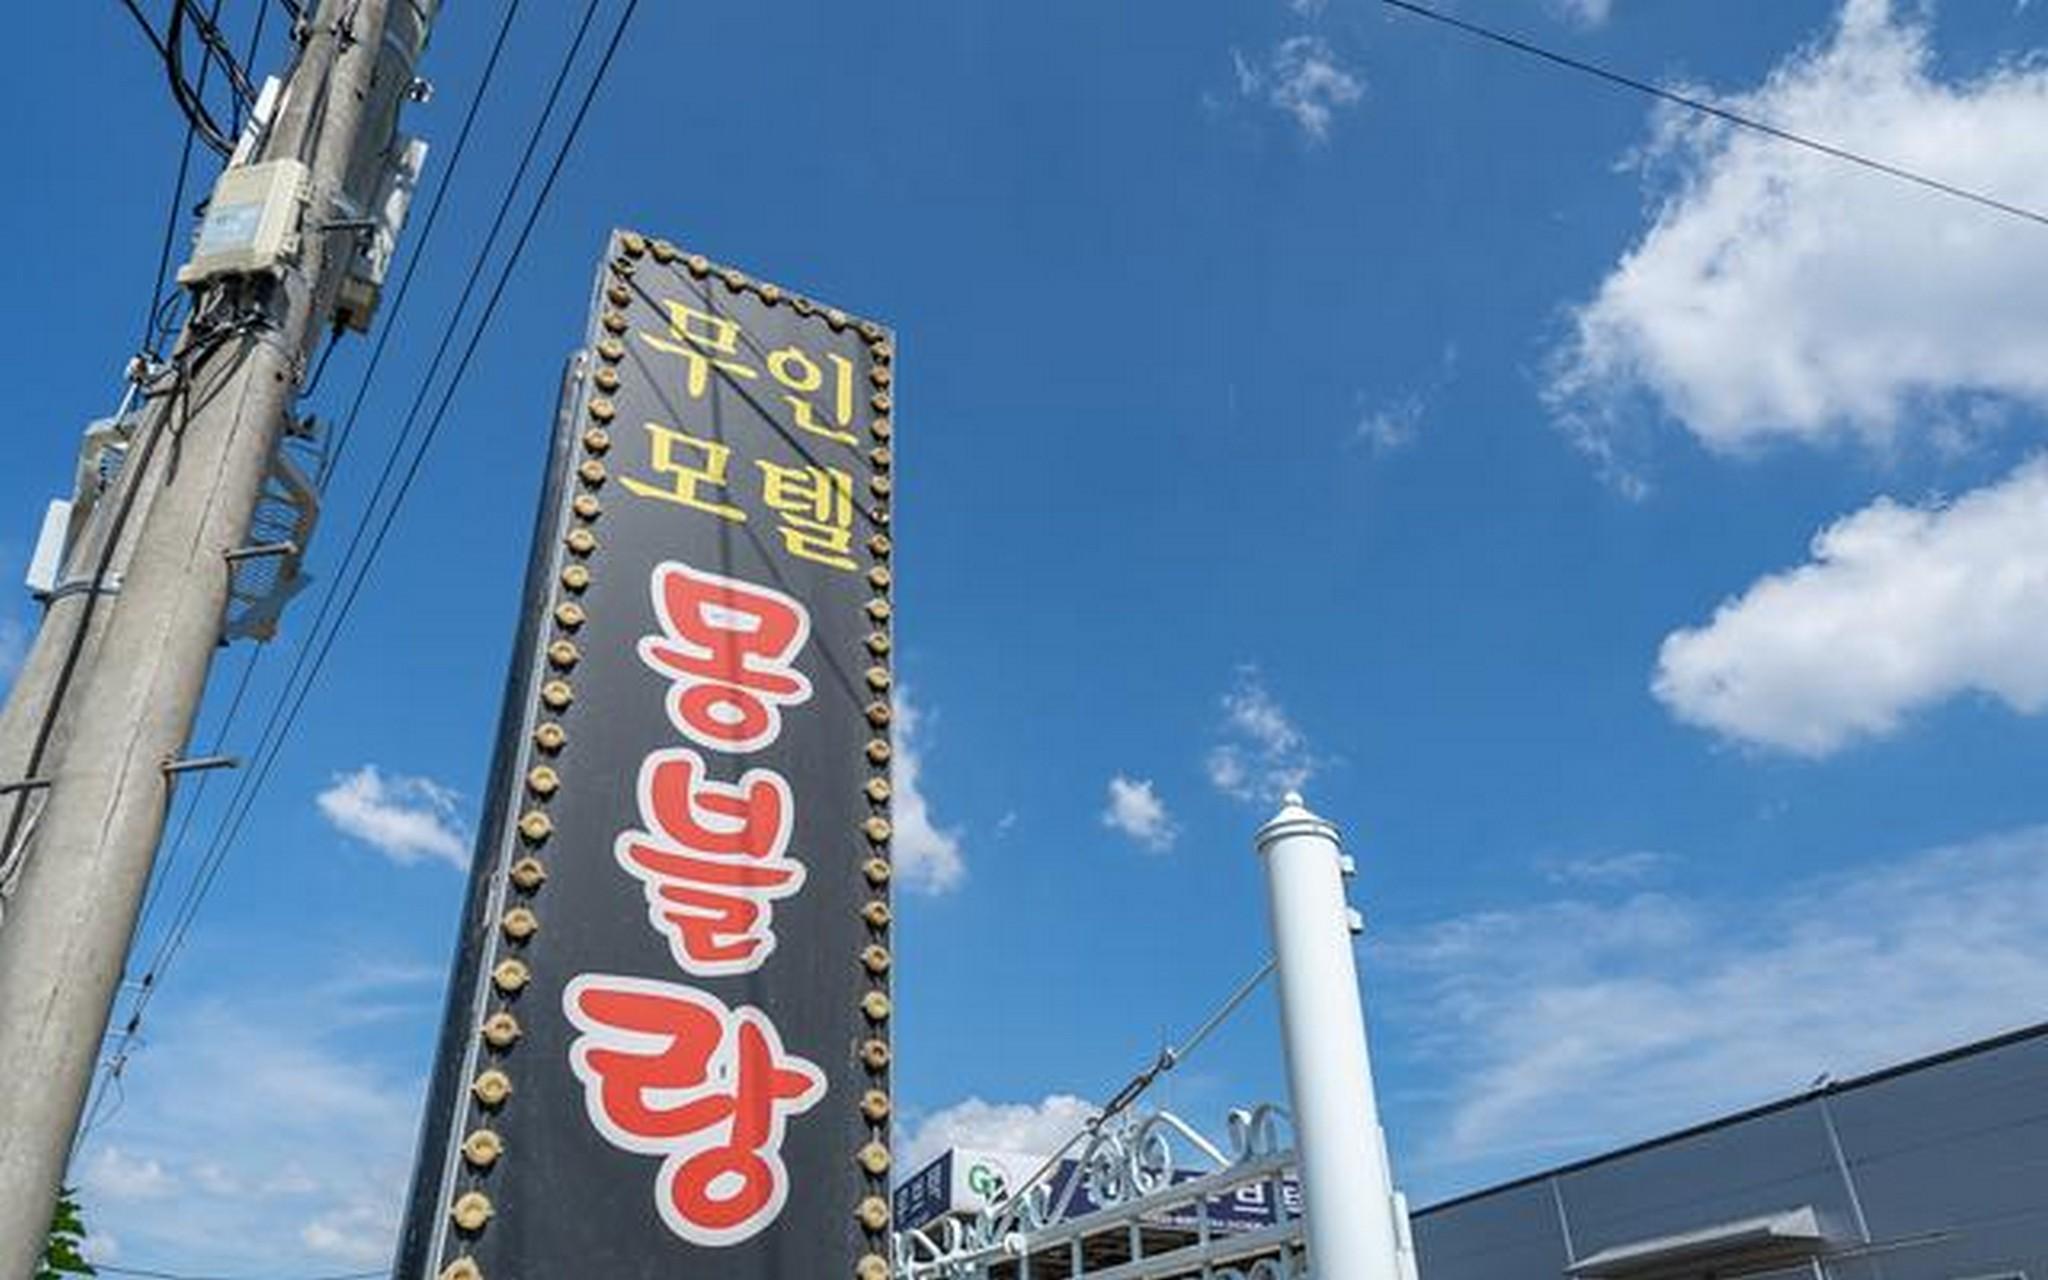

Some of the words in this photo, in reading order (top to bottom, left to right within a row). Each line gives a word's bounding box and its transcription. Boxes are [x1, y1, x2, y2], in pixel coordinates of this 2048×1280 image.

[639, 298, 859, 446] 무인
[618, 421, 859, 571] 모텔
[563, 562, 827, 1246] 몽블랑
